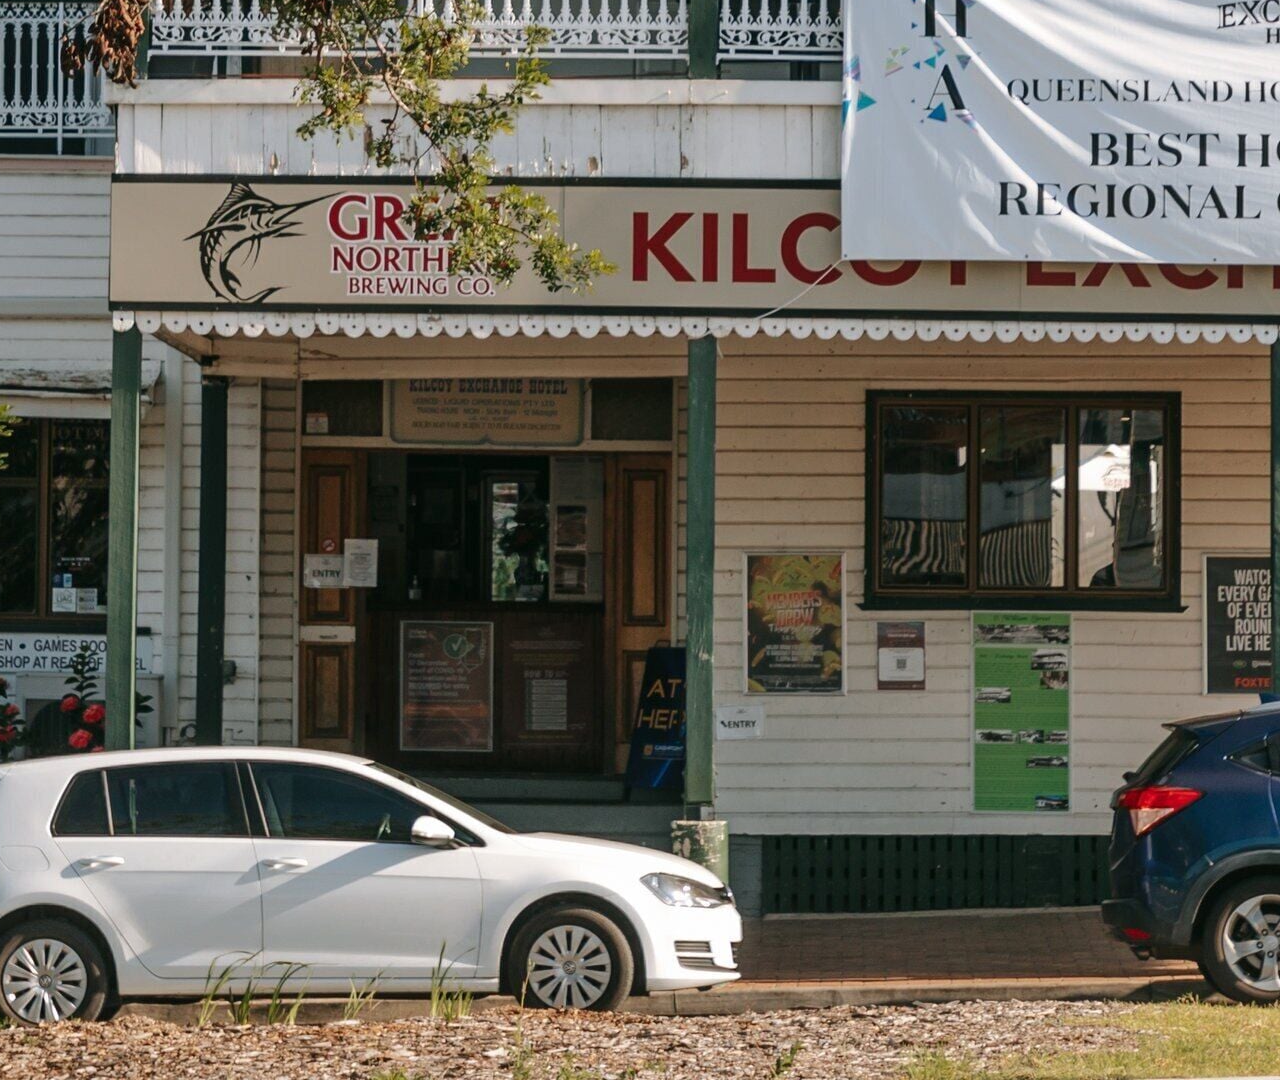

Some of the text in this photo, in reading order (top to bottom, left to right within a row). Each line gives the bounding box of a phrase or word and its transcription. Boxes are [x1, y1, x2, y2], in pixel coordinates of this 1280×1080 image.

[1006, 78, 1233, 106] QUEENSLAND
[1089, 132, 1221, 168] BEST
[998, 181, 1262, 220] REGIONAL
[631, 211, 967, 287] KILC
[349, 277, 495, 295] BREWING CO.
[409, 379, 454, 393] KILCOY
[529, 380, 568, 395] HOTEL
[312, 569, 341, 578] ENTRY
[1218, 586, 1255, 602] EVERY
[1227, 602, 1243, 618] OF
[33, 639, 77, 653] GAMES
[1226, 635, 1252, 651] LIVE
[32, 656, 48, 668] AT
[646, 678, 687, 698] AT
[727, 720, 757, 729] ENTRY
